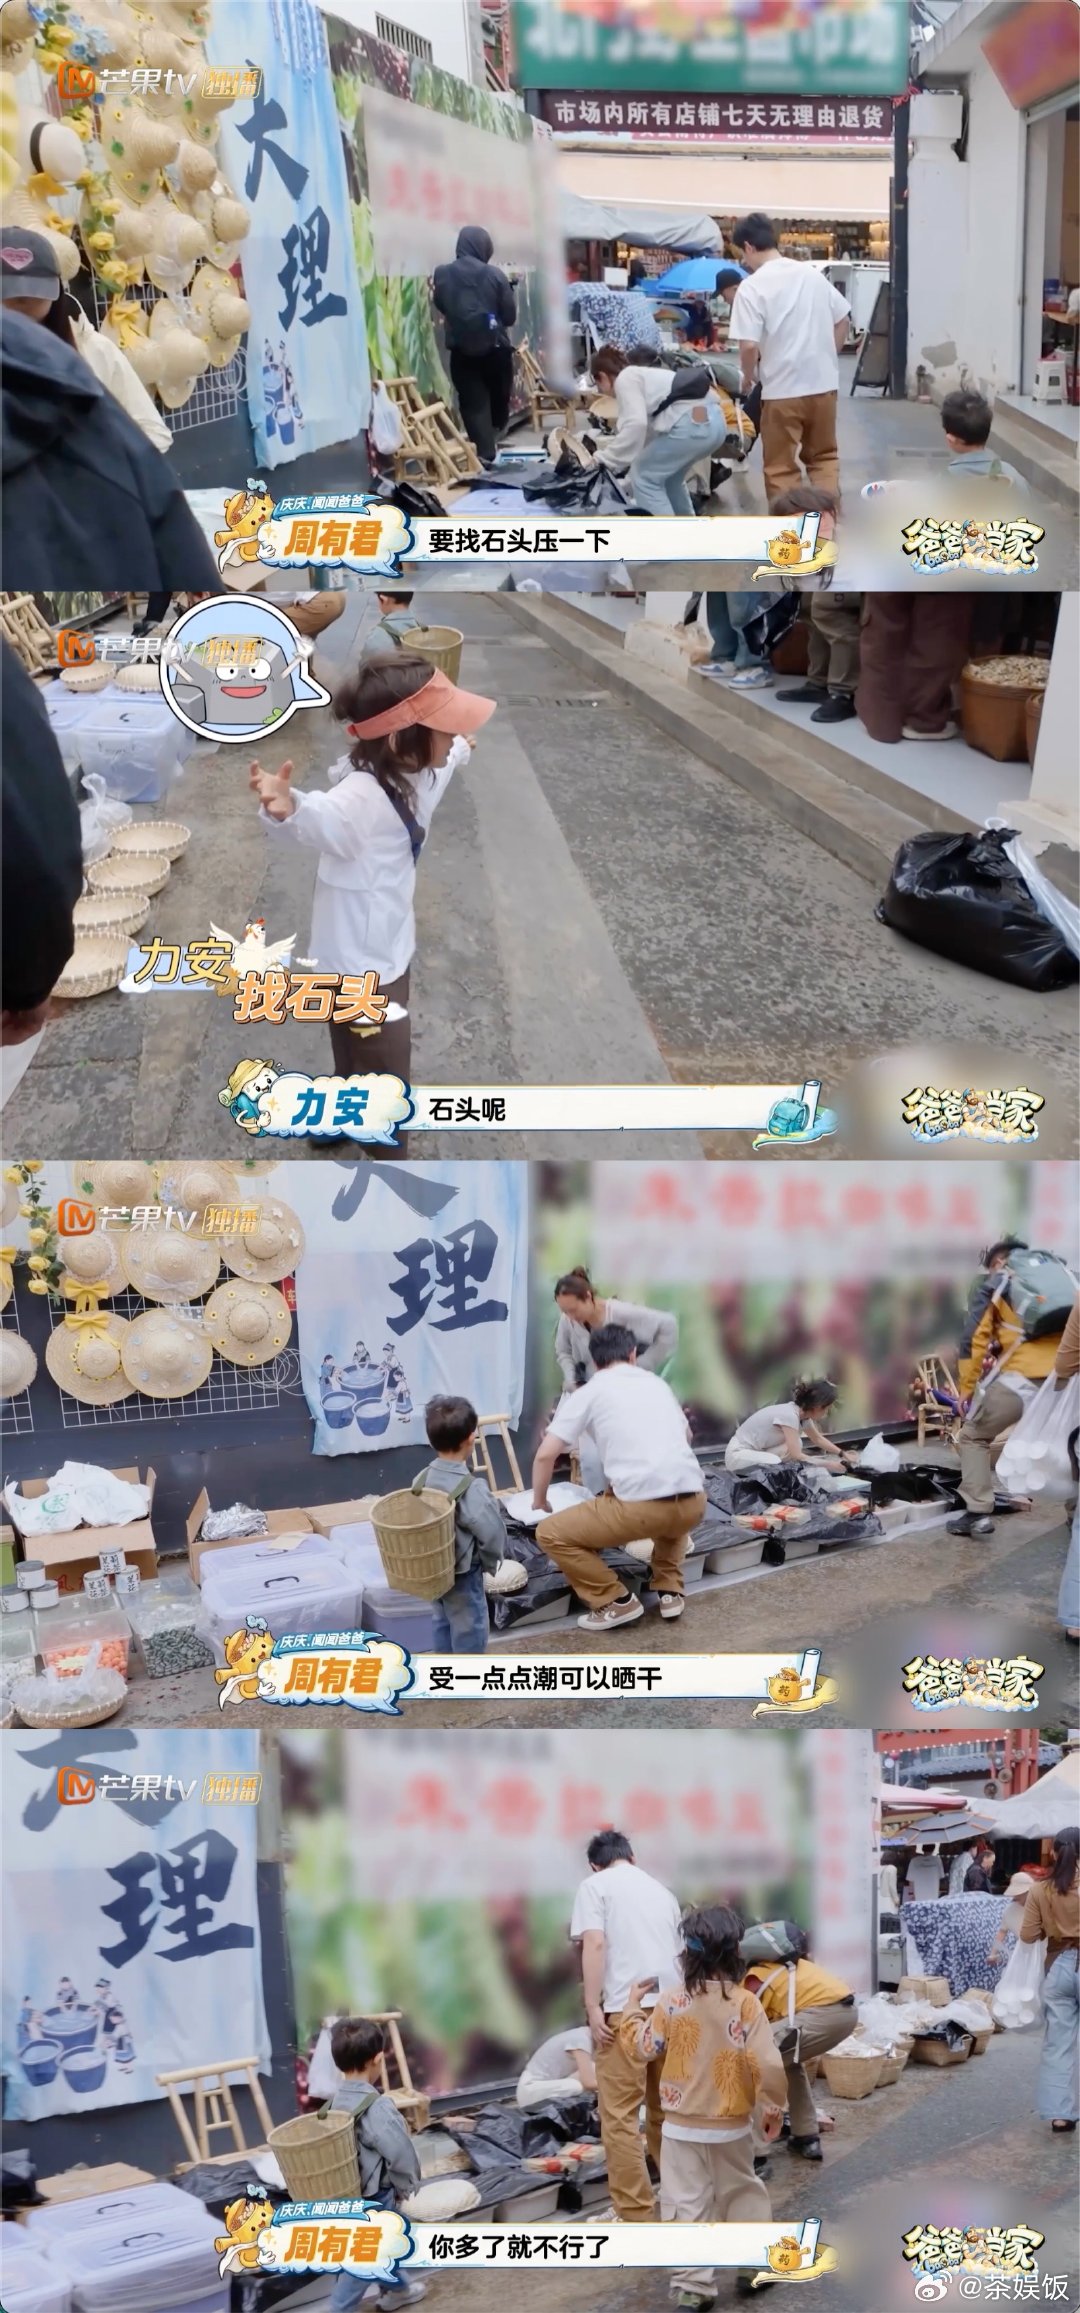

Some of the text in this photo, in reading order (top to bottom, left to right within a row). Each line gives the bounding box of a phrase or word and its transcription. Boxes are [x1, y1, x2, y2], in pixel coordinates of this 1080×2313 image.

[555, 101, 884, 129] 市场内所有店铺七天无理由退货
